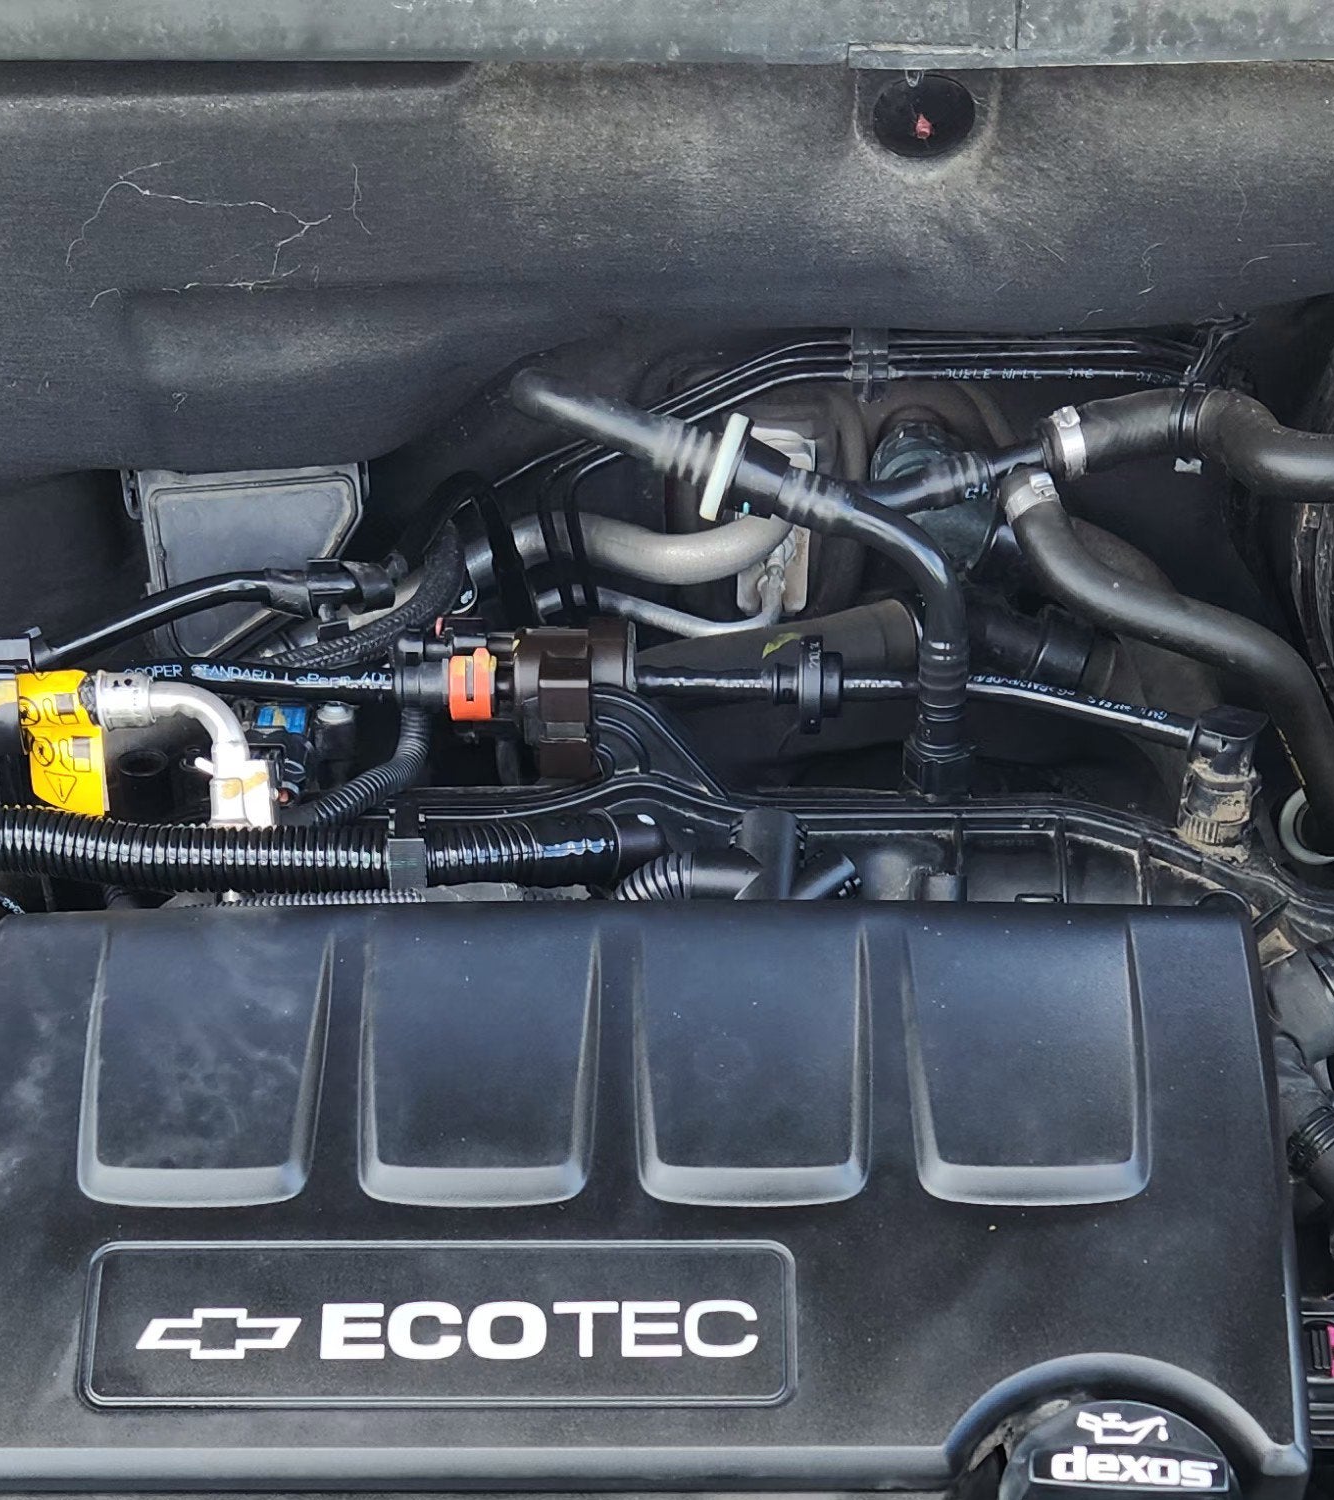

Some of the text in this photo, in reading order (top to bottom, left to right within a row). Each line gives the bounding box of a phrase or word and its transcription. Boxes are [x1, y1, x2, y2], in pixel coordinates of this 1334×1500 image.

[191, 664, 275, 681] STANDARD
[320, 1300, 759, 1360] ECOTEC
[1051, 1446, 1218, 1488] dexos
